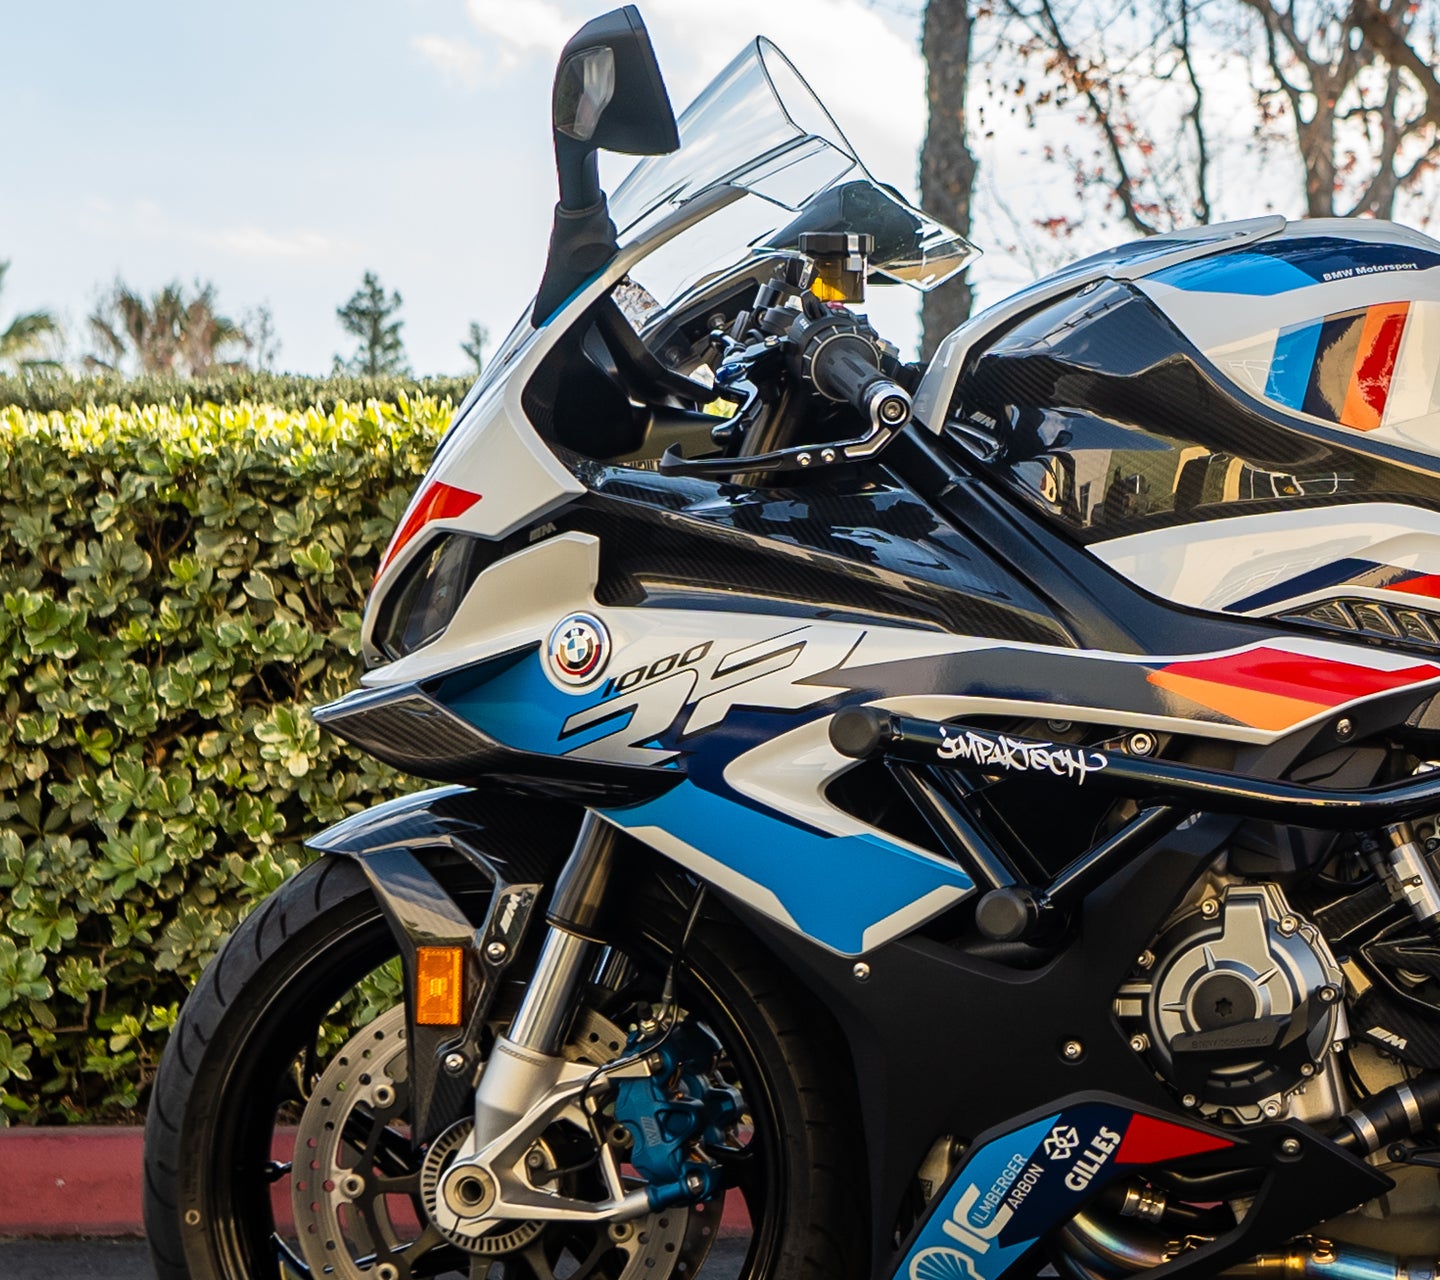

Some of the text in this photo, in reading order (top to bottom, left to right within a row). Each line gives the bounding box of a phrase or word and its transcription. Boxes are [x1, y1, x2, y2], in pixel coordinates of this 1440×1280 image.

[1322, 262, 1419, 281] BMW Motorsport
[601, 640, 715, 699] 1000
[970, 1153, 1029, 1225] ILMBERGER
[1064, 1125, 1122, 1192] GILLES
